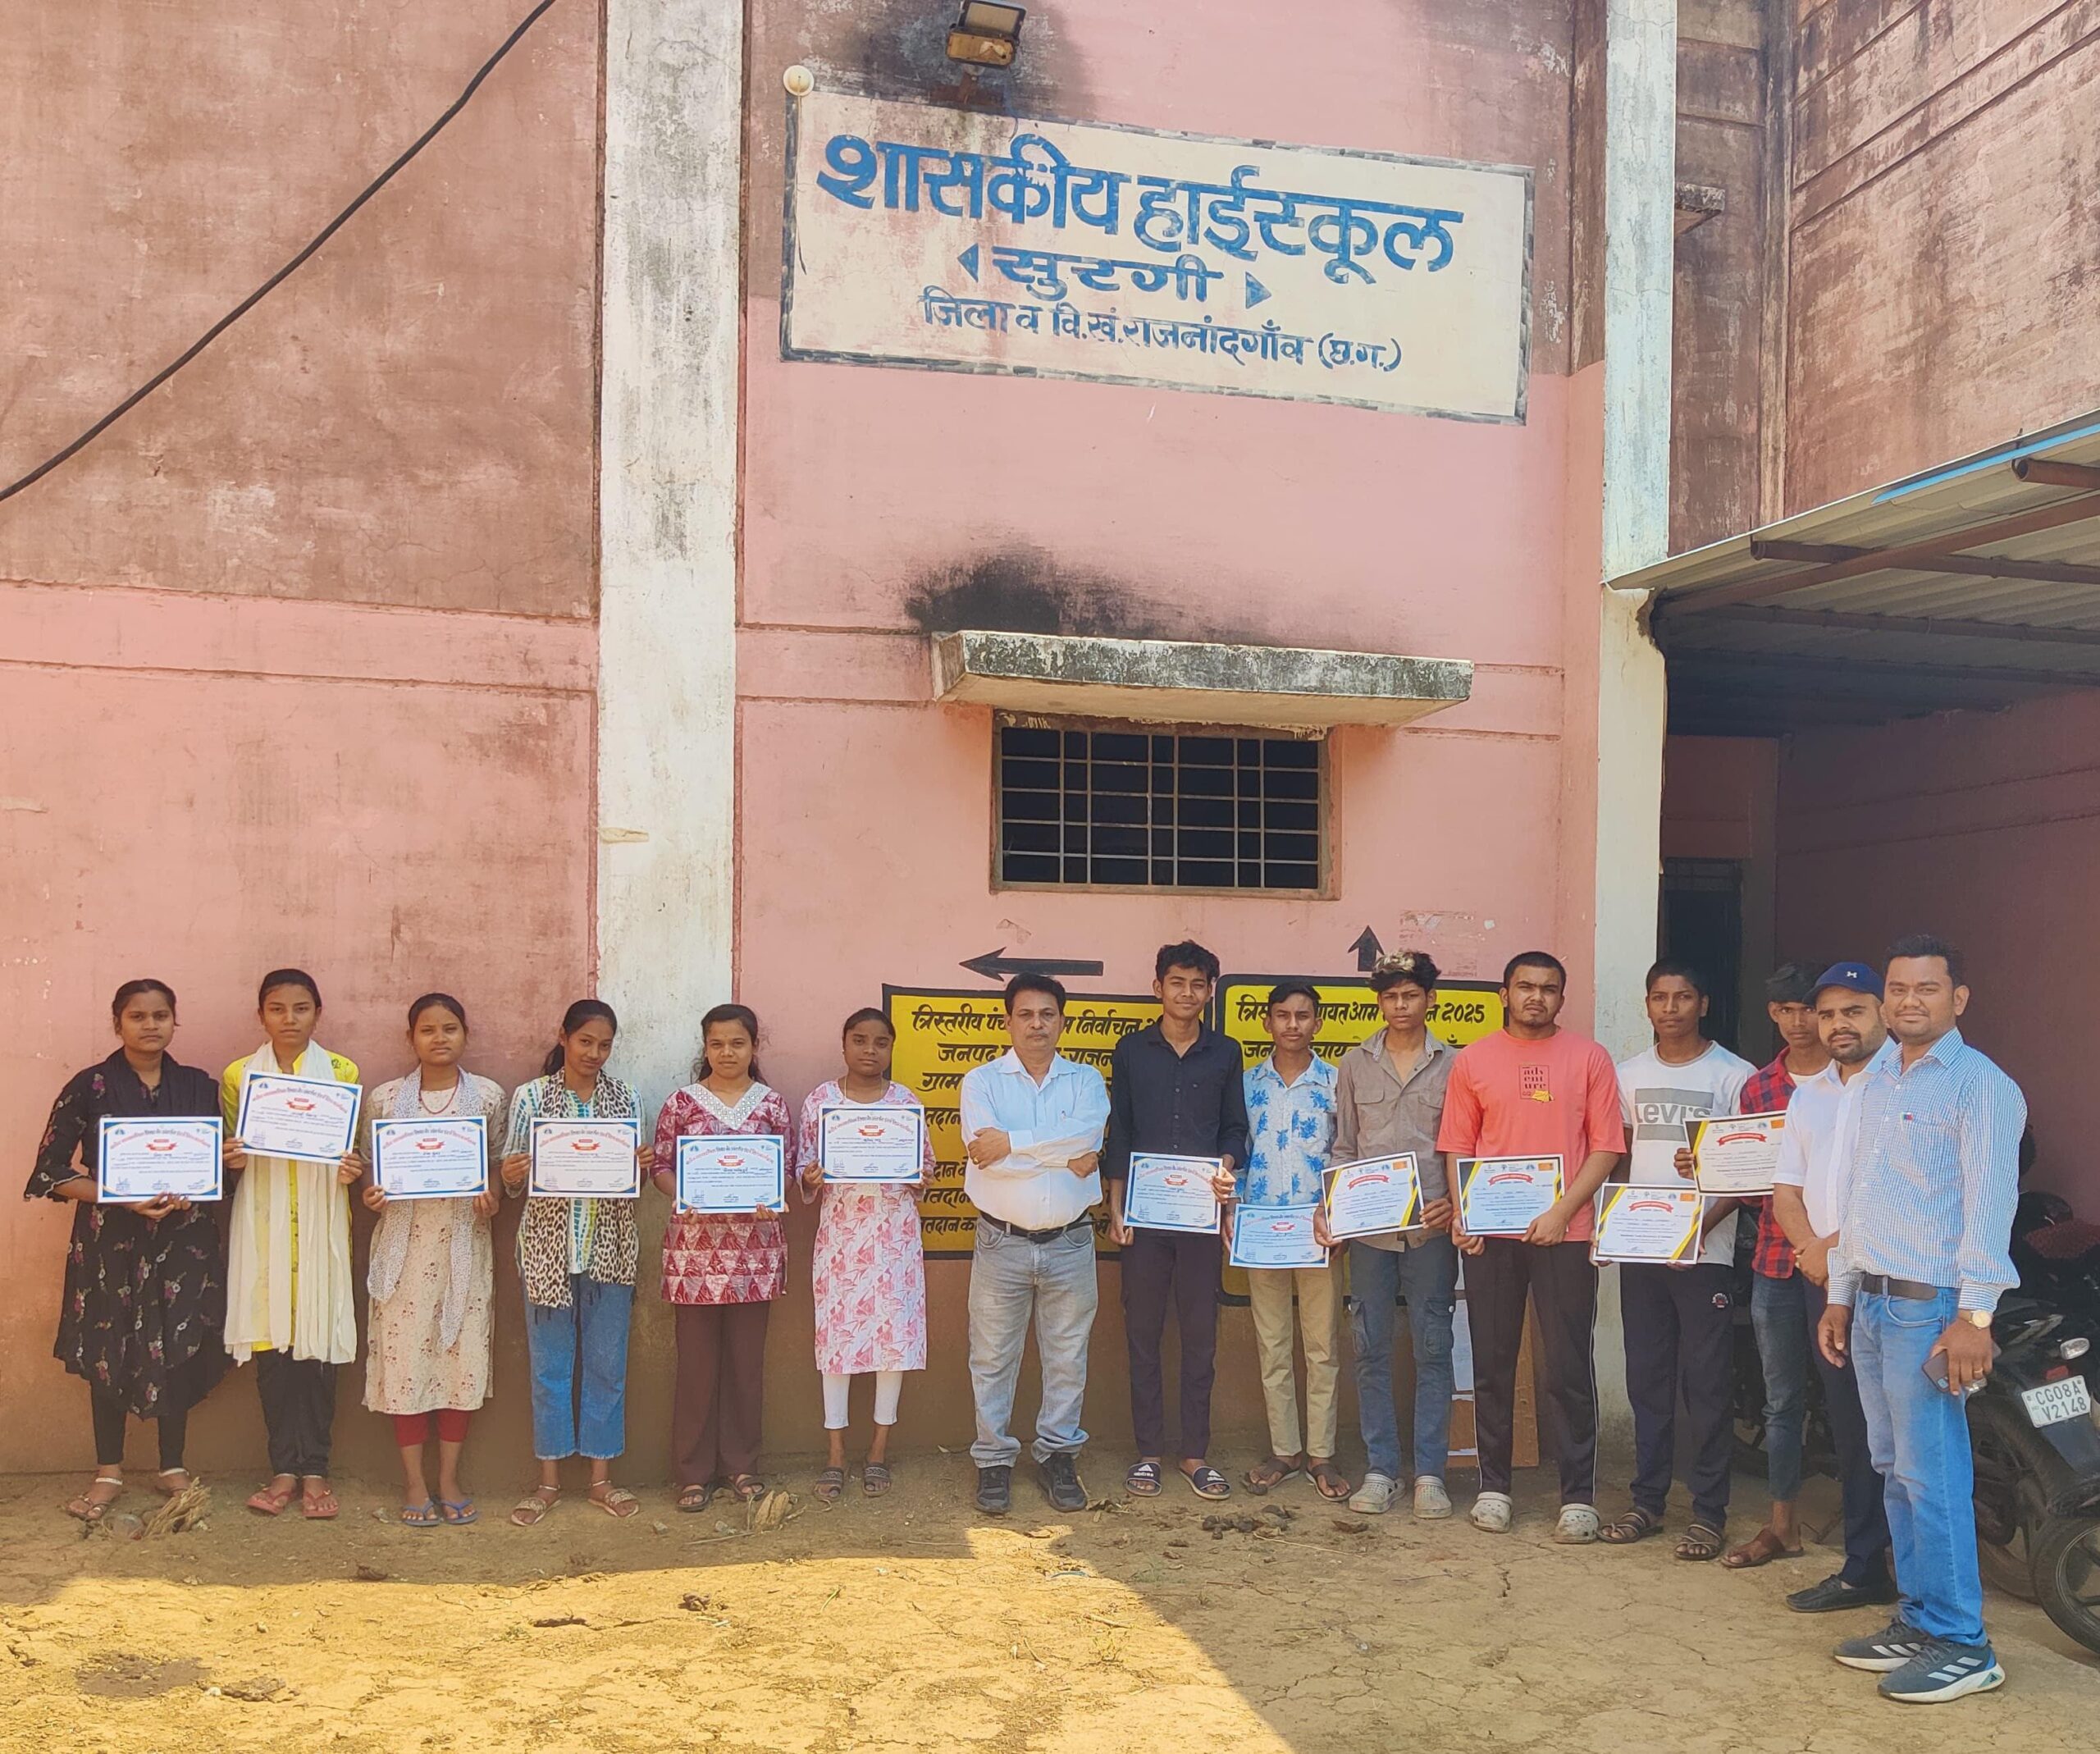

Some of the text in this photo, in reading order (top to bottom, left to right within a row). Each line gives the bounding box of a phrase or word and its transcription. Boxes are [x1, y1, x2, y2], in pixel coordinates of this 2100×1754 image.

[816, 133, 1463, 285] शासकीय हाईस्कूल
[918, 285, 1016, 334] जिला
[911, 1003, 986, 1036] त्रिस्तरीय
[2034, 1380, 2082, 1405] CG08A
[2041, 1396, 2087, 1421] V2148
